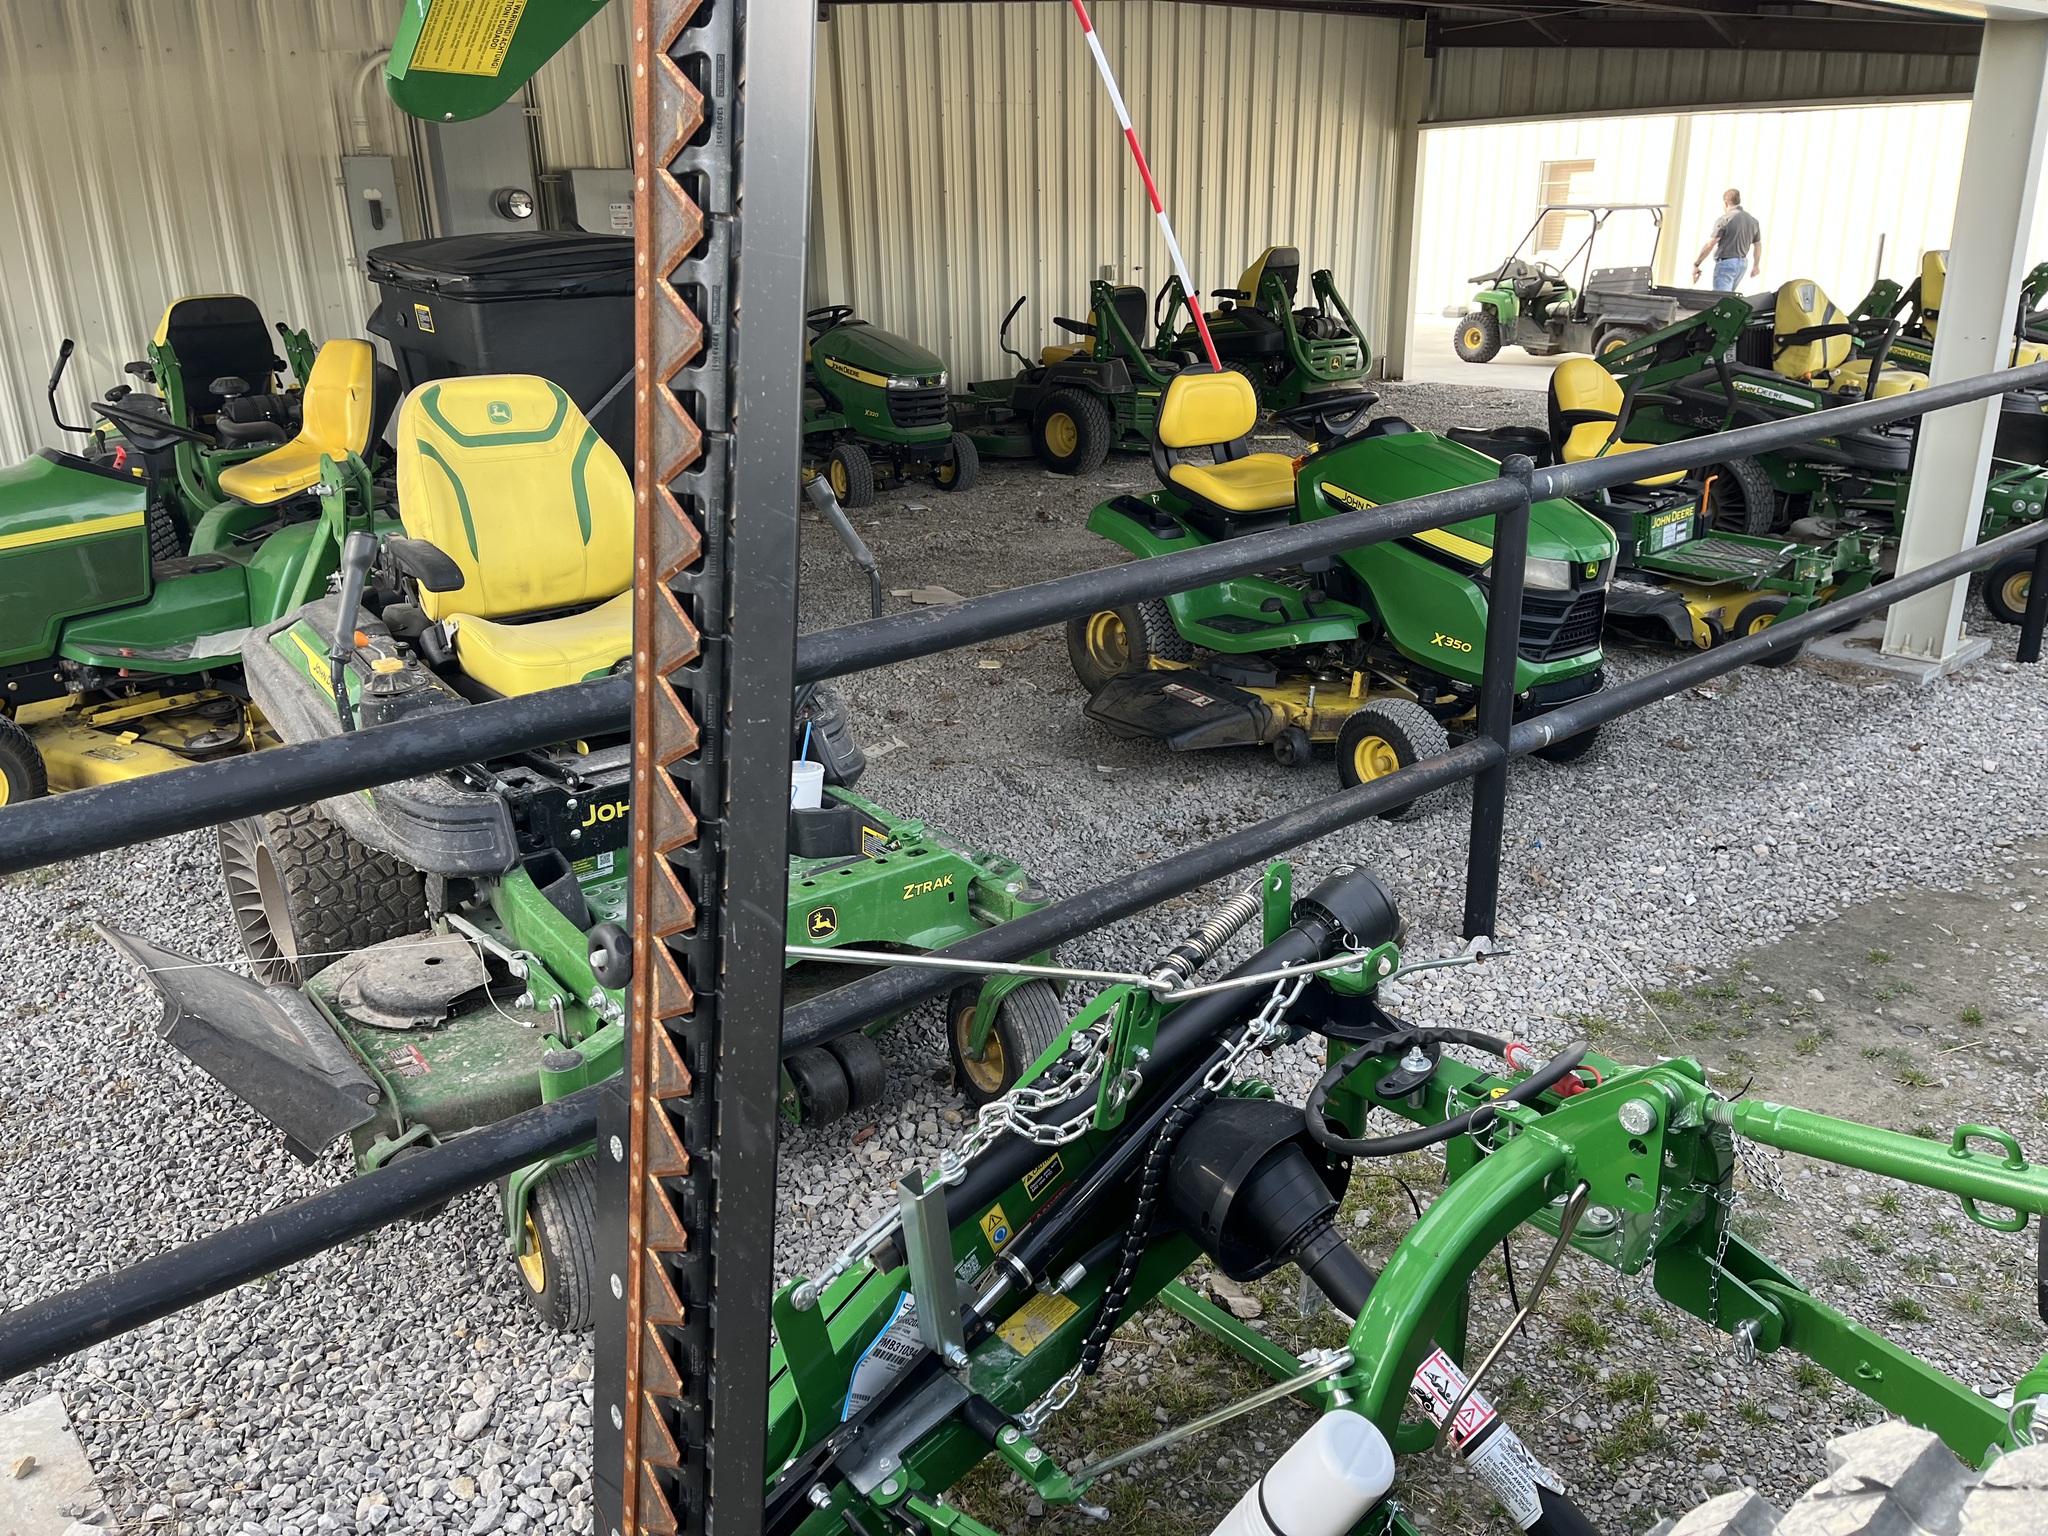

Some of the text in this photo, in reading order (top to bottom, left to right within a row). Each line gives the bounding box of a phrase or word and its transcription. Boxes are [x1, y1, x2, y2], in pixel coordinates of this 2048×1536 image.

[489, 20, 506, 49] CUIDADO!
[490, 4, 521, 69] WARNING! ACHTUNG!
[833, 362, 860, 377] JOHN DEERE
[1757, 386, 1783, 399] DEERE
[1341, 492, 1365, 510] JOHN
[1651, 506, 1695, 529] JOHN DEERE
[1430, 632, 1472, 653] X350
[903, 873, 954, 901] ZTRAK
[1498, 1443, 1519, 1467] ROTATING
[1499, 1461, 1530, 1494] KEEP AWAY!
[1500, 1471, 1516, 1489] OPERATE
